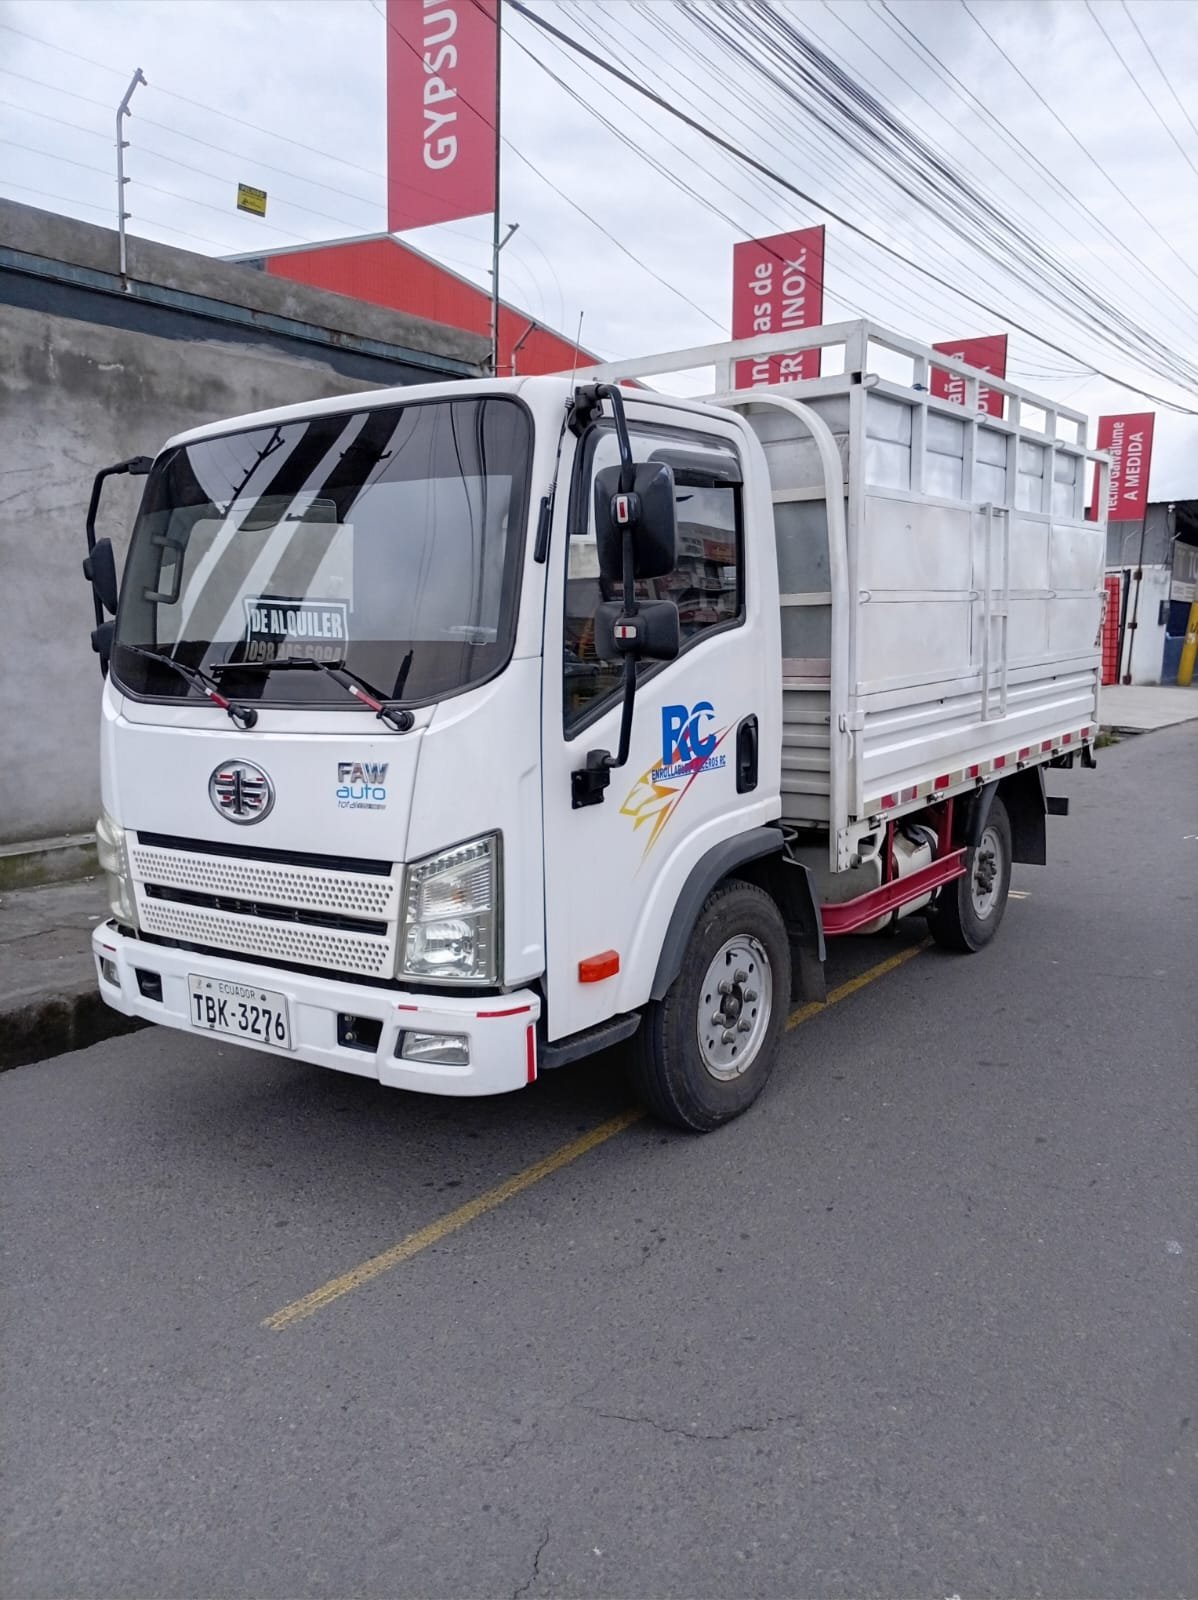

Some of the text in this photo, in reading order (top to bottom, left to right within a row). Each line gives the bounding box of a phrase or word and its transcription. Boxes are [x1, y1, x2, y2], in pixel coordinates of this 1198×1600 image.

[423, 0, 458, 169] GYPSU
[748, 262, 773, 295] de
[781, 248, 807, 328] INOX.
[1123, 432, 1144, 501] A MEDIDA
[250, 608, 343, 638] DE ALQUILER
[662, 701, 716, 765] RC
[336, 783, 386, 800] auto
[338, 762, 388, 784] FAW
[219, 982, 256, 999] ECUADOR
[193, 993, 285, 1041] TBK-3276
